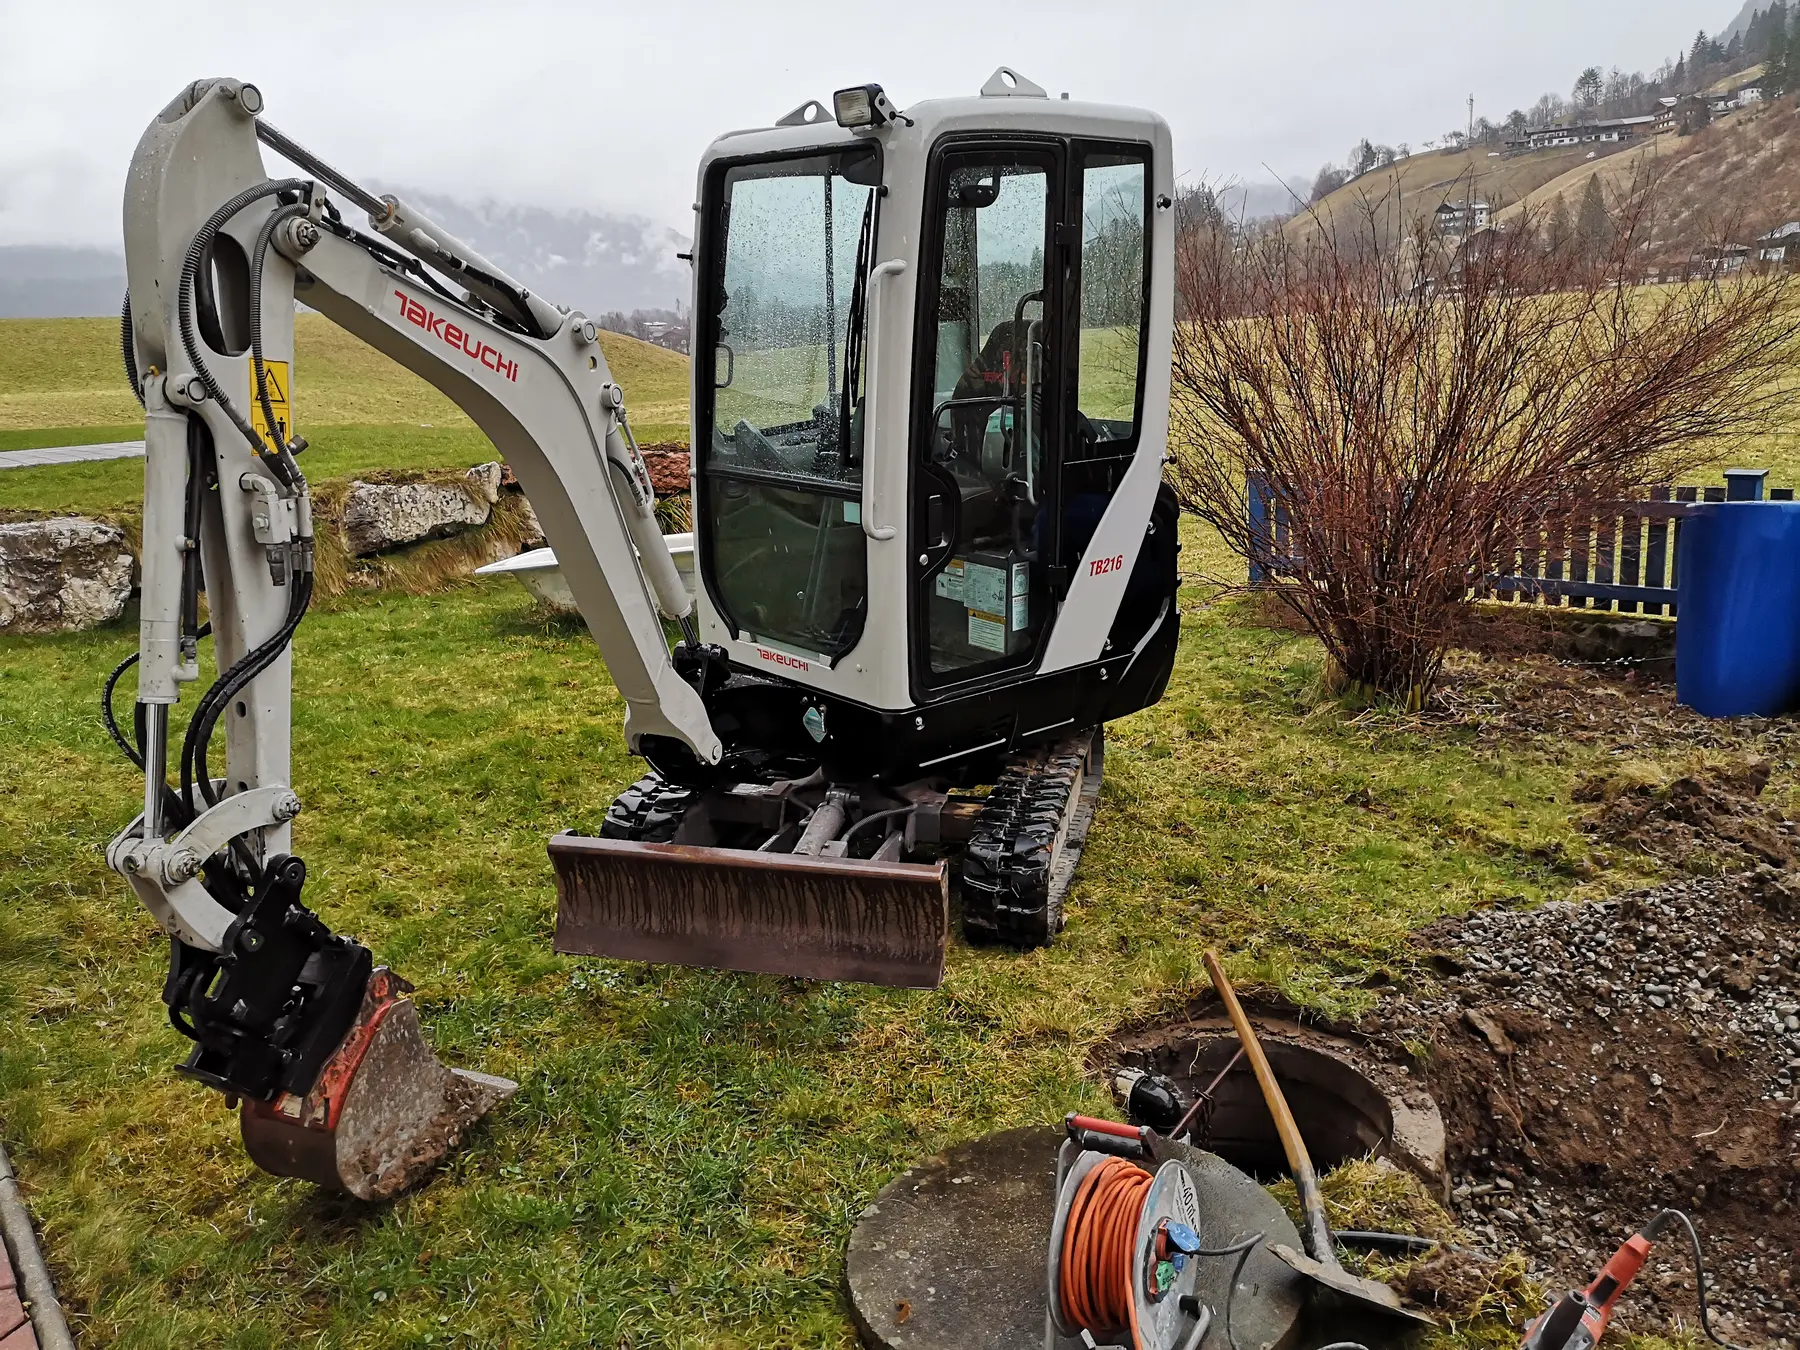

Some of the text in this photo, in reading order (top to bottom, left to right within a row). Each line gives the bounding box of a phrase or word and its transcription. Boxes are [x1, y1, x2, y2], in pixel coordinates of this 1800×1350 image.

[394, 290, 518, 382] TAKEUCHI
[1090, 554, 1123, 577] TB216
[757, 648, 808, 671] TAKEUCHI
